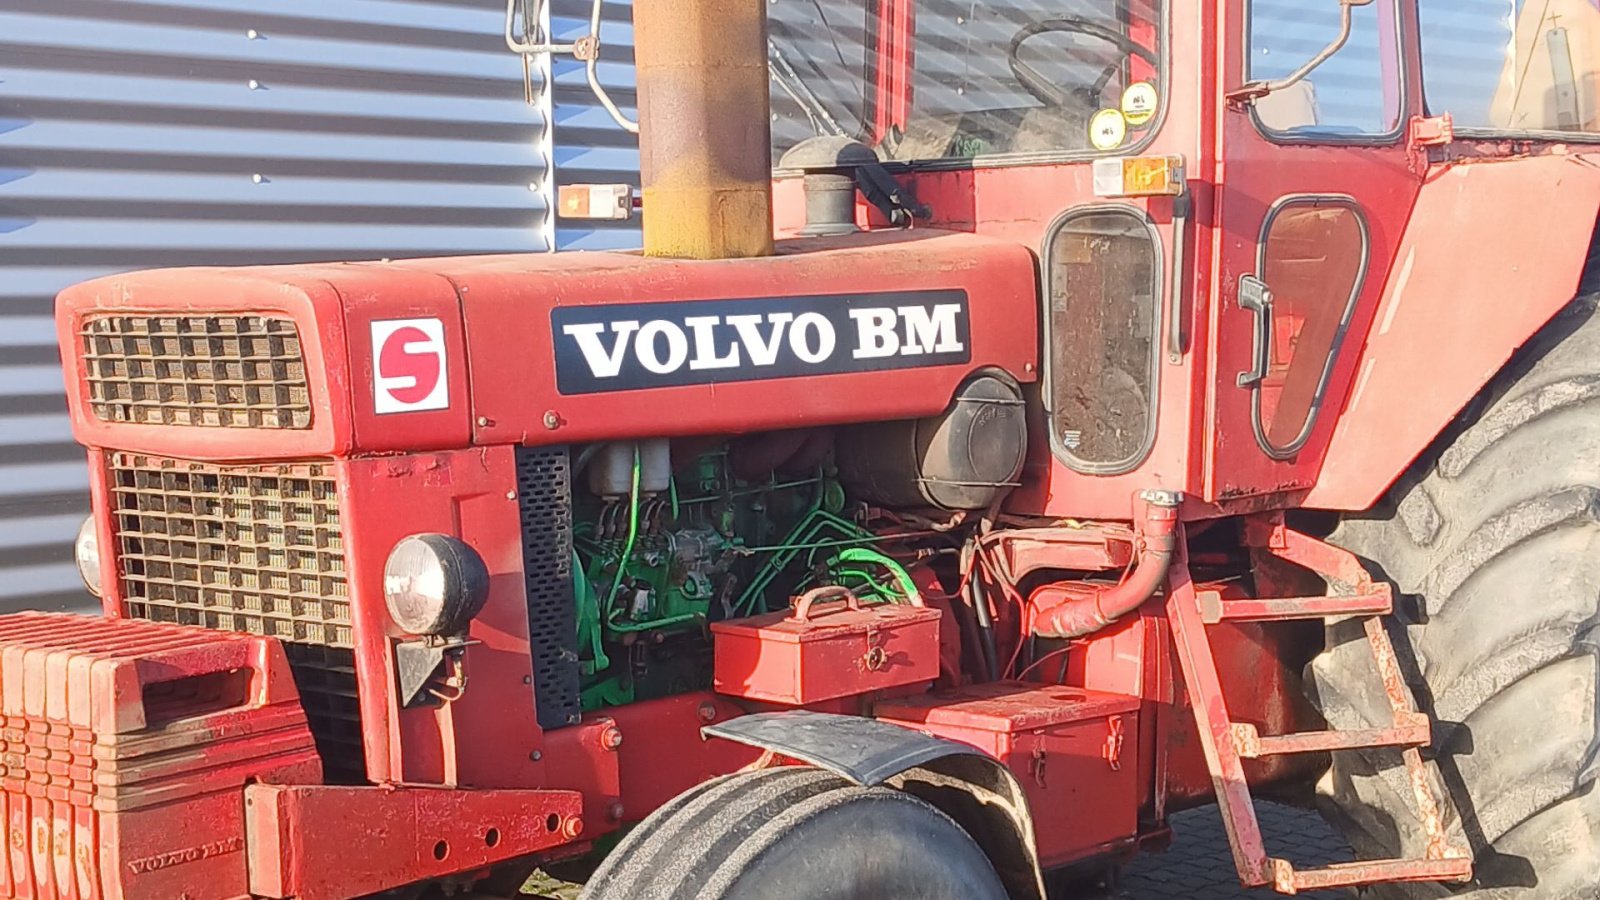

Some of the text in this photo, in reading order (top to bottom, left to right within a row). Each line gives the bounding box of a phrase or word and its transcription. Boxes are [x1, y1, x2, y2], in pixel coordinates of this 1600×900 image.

[562, 303, 964, 378] VOLVO BM
[127, 847, 202, 875] VOLVO
